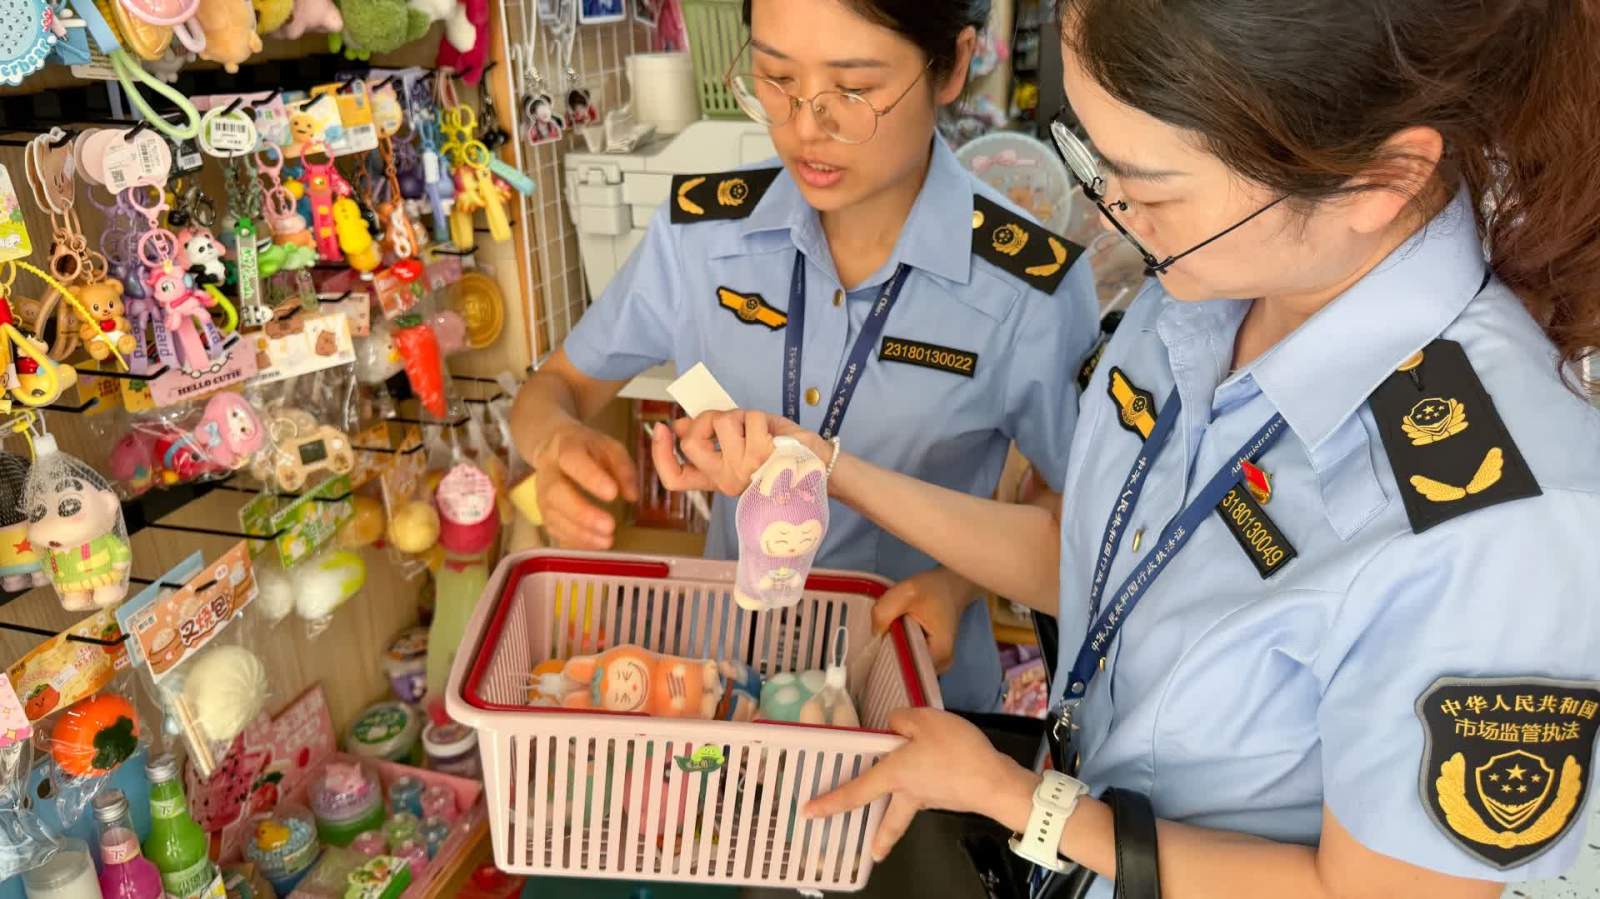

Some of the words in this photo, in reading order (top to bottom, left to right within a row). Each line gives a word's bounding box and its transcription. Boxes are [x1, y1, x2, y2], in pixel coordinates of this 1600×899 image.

[884, 342, 973, 371] 23180130022
[178, 379, 211, 396] HELLO
[213, 369, 241, 384] CUTIE
[1091, 526, 1187, 652] 中华人民共和国行政执法证
[180, 593, 231, 645] 叉烧包
[1440, 694, 1599, 720] 中华人民共和国
[1454, 718, 1581, 743] 市场监管执法
